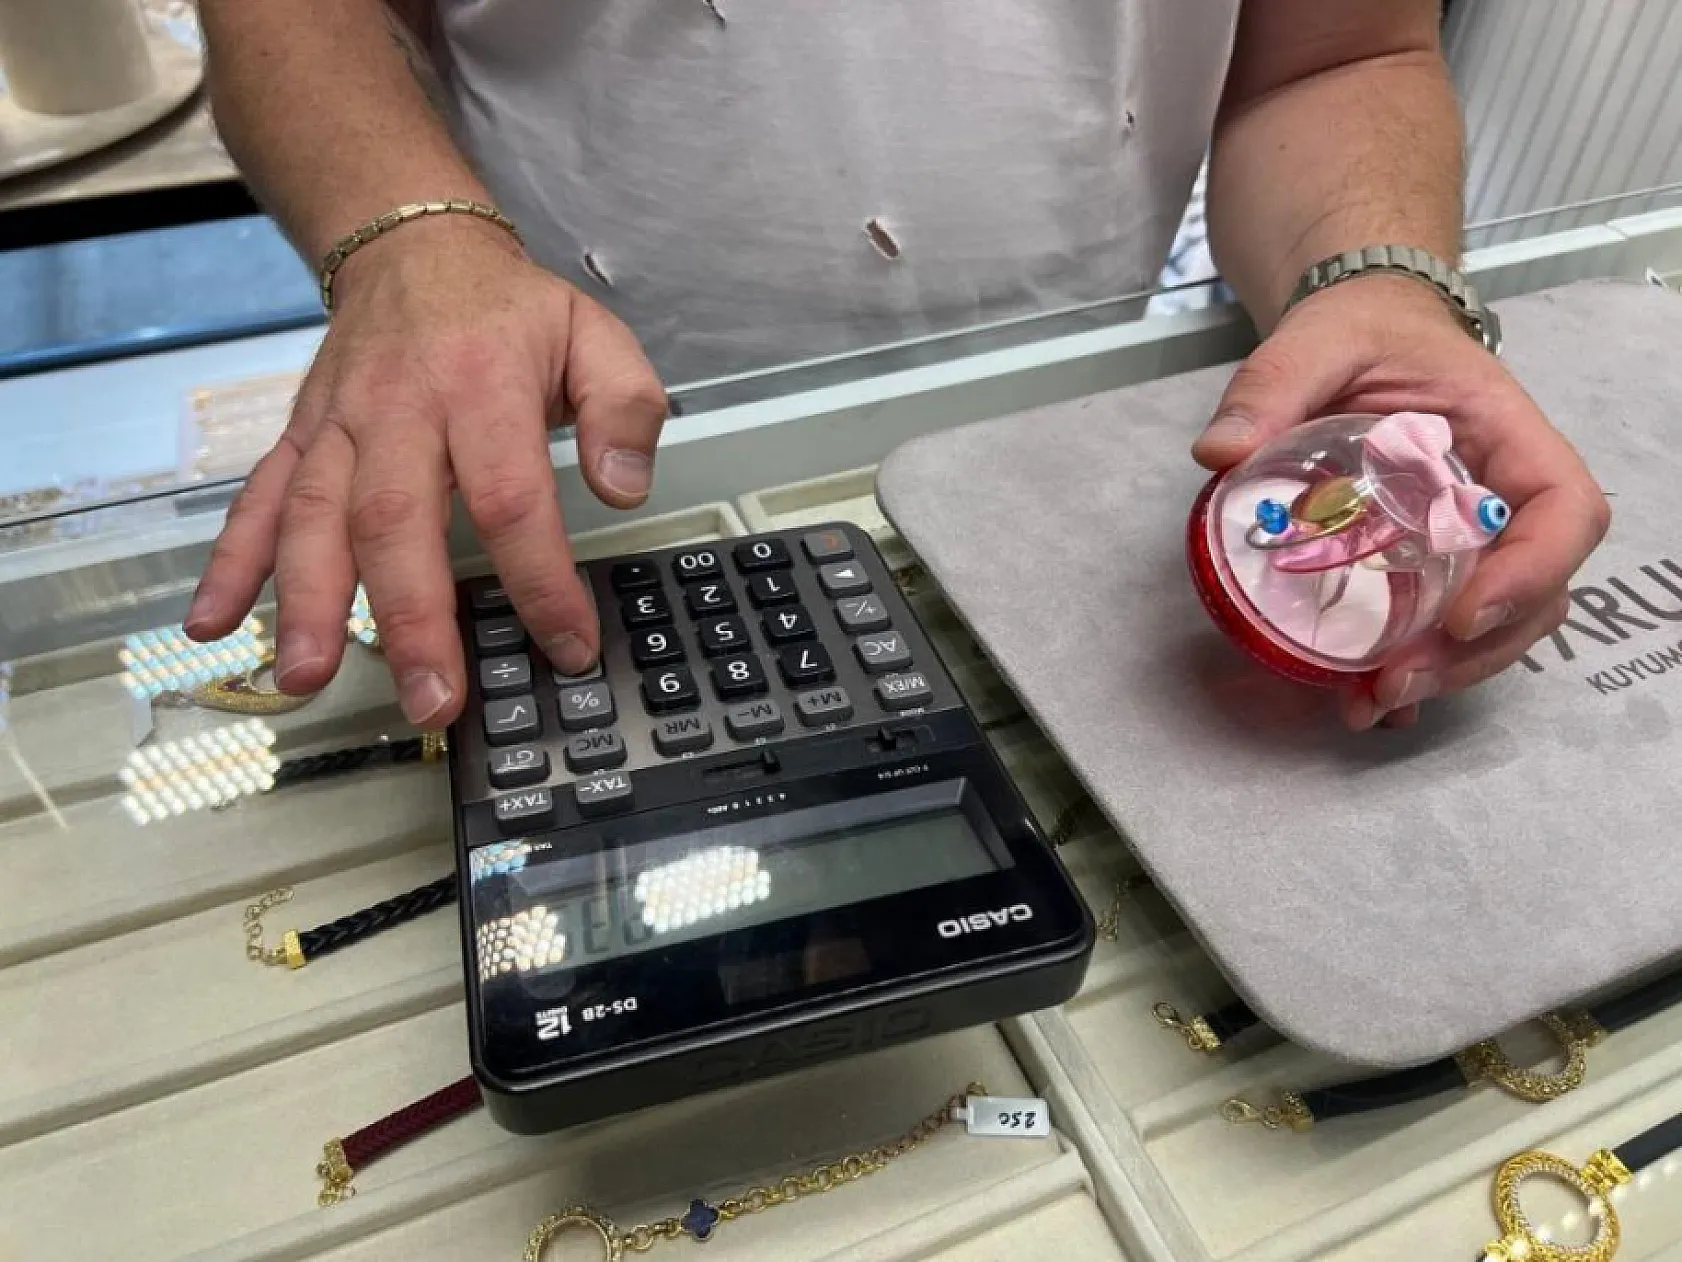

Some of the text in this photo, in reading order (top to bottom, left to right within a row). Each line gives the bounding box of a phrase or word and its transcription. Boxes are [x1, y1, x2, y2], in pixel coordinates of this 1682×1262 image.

[752, 541, 772, 558] 0
[680, 551, 715, 569] 00
[701, 584, 721, 602] 2
[766, 576, 781, 592] 1
[636, 595, 656, 614] 3
[778, 612, 798, 630] 4
[714, 621, 735, 641] 5
[646, 632, 667, 652] 6
[863, 637, 897, 656] AC
[799, 650, 818, 669] 7
[1585, 639, 1682, 695] KUYUM
[727, 659, 750, 680] 8
[659, 673, 681, 693] 9
[808, 690, 842, 706] M+
[664, 717, 700, 735] MR
[575, 733, 614, 751] MC
[505, 750, 535, 768] GT
[500, 792, 548, 811] TAX+
[937, 903, 1033, 938] CASIO
[536, 1013, 572, 1041] 12
